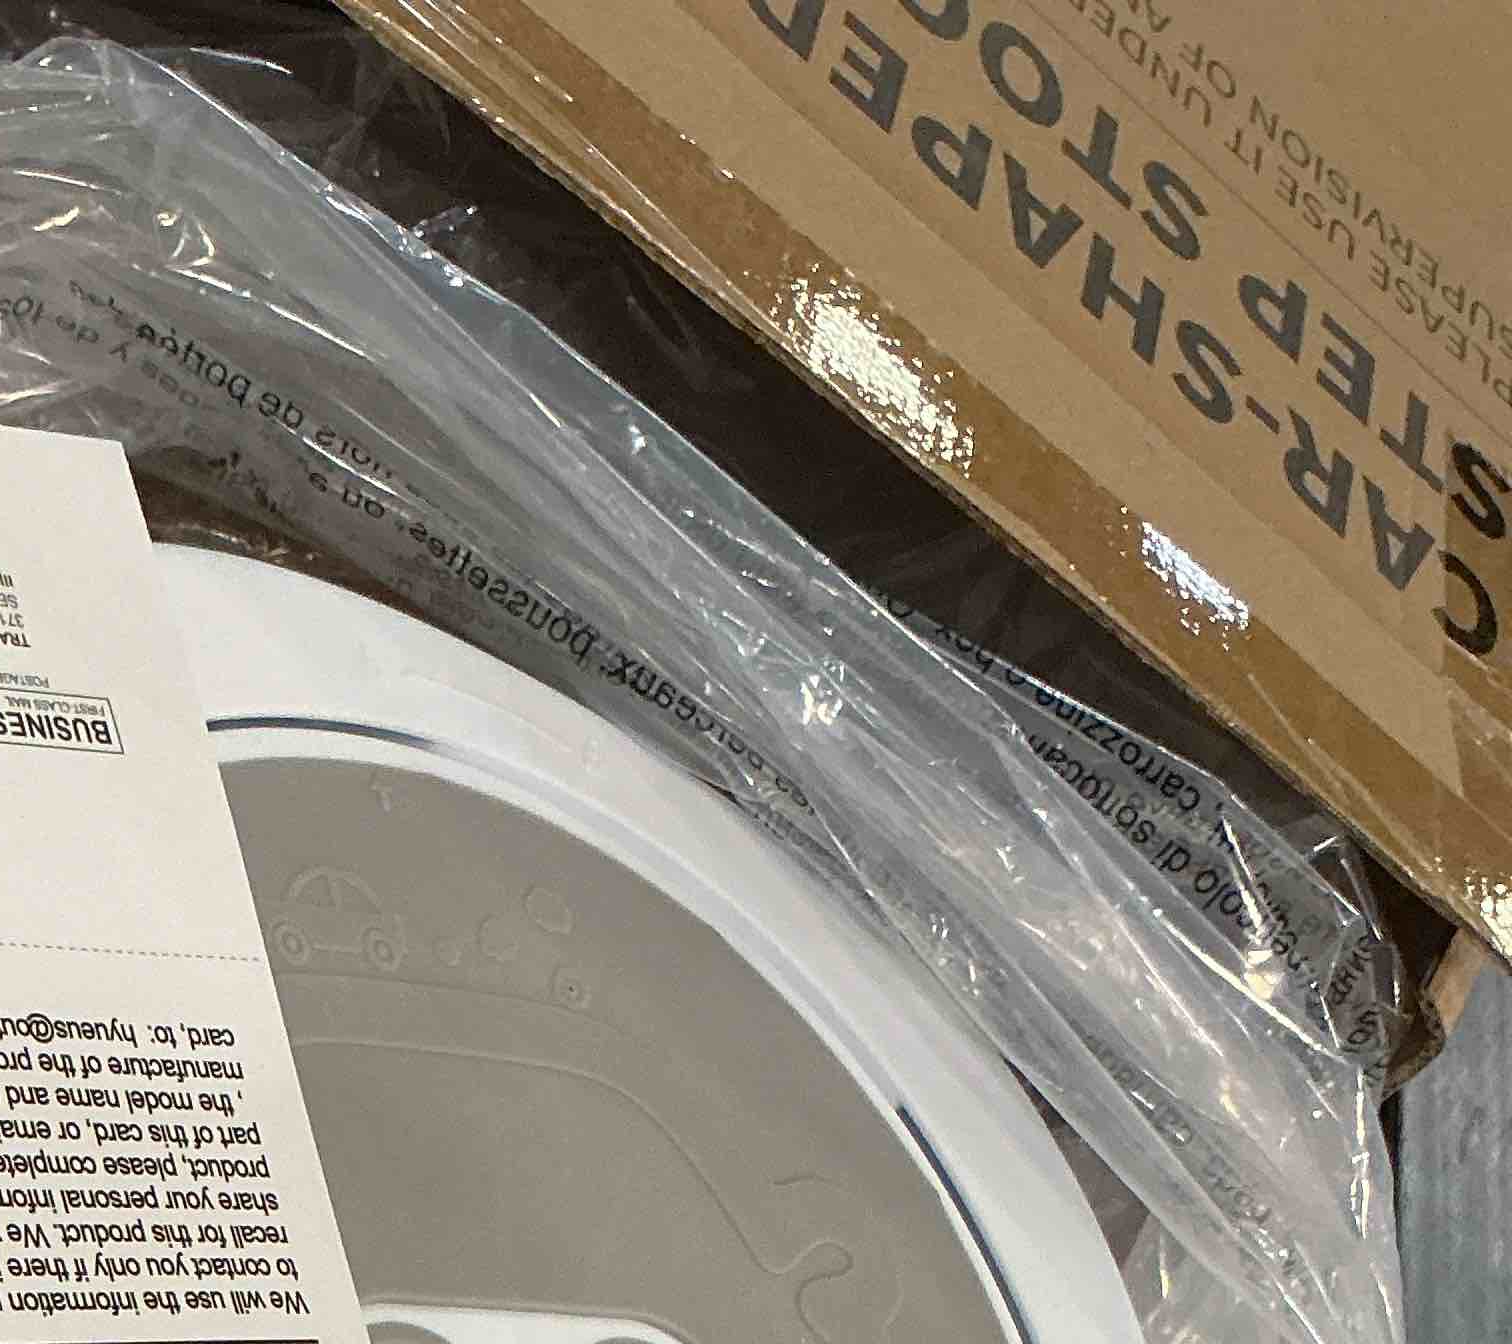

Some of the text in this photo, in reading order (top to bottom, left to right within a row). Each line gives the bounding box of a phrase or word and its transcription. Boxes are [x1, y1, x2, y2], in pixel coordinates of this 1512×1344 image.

[1068, 0, 1212, 128] UNDE
[1178, 43, 1236, 98] OF
[1224, 128, 1262, 175] IT
[1275, 165, 1356, 260] USE
[1240, 274, 1512, 539] STEP
[1148, 839, 1191, 874] di
[146, 1024, 178, 1050] to:
[178, 1021, 236, 1052] card,
[36, 1052, 78, 1079] the
[79, 1054, 103, 1080] of
[106, 1055, 245, 1084] manufacture
[3, 1084, 51, 1112] and
[53, 1086, 122, 1109] name
[123, 1088, 195, 1116] model
[197, 1092, 236, 1119] the
[56, 1120, 82, 1141] or
[84, 1117, 144, 1148] card,
[146, 1123, 190, 1150] this
[191, 1124, 215, 1151] of
[215, 1121, 263, 1151] part
[101, 1150, 179, 1183] please
[180, 1152, 272, 1184] product,
[58, 1184, 161, 1215] personal
[164, 1184, 217, 1211] your
[216, 1191, 280, 1218] share
[5, 1222, 53, 1249] We
[51, 1217, 148, 1250] product.
[150, 1223, 194, 1249] this
[196, 1223, 228, 1249] for
[228, 1223, 290, 1250] recall
[5, 1256, 71, 1284] there
[72, 1257, 91, 1284] if
[93, 1250, 142, 1284] only
[144, 1250, 191, 1277] you
[188, 1256, 272, 1282] contact
[275, 1256, 300, 1283] to
[6, 1290, 142, 1319] information
[141, 1290, 182, 1317] the
[182, 1289, 228, 1311] use
[228, 1289, 268, 1316] will
[267, 1289, 312, 1316] We
